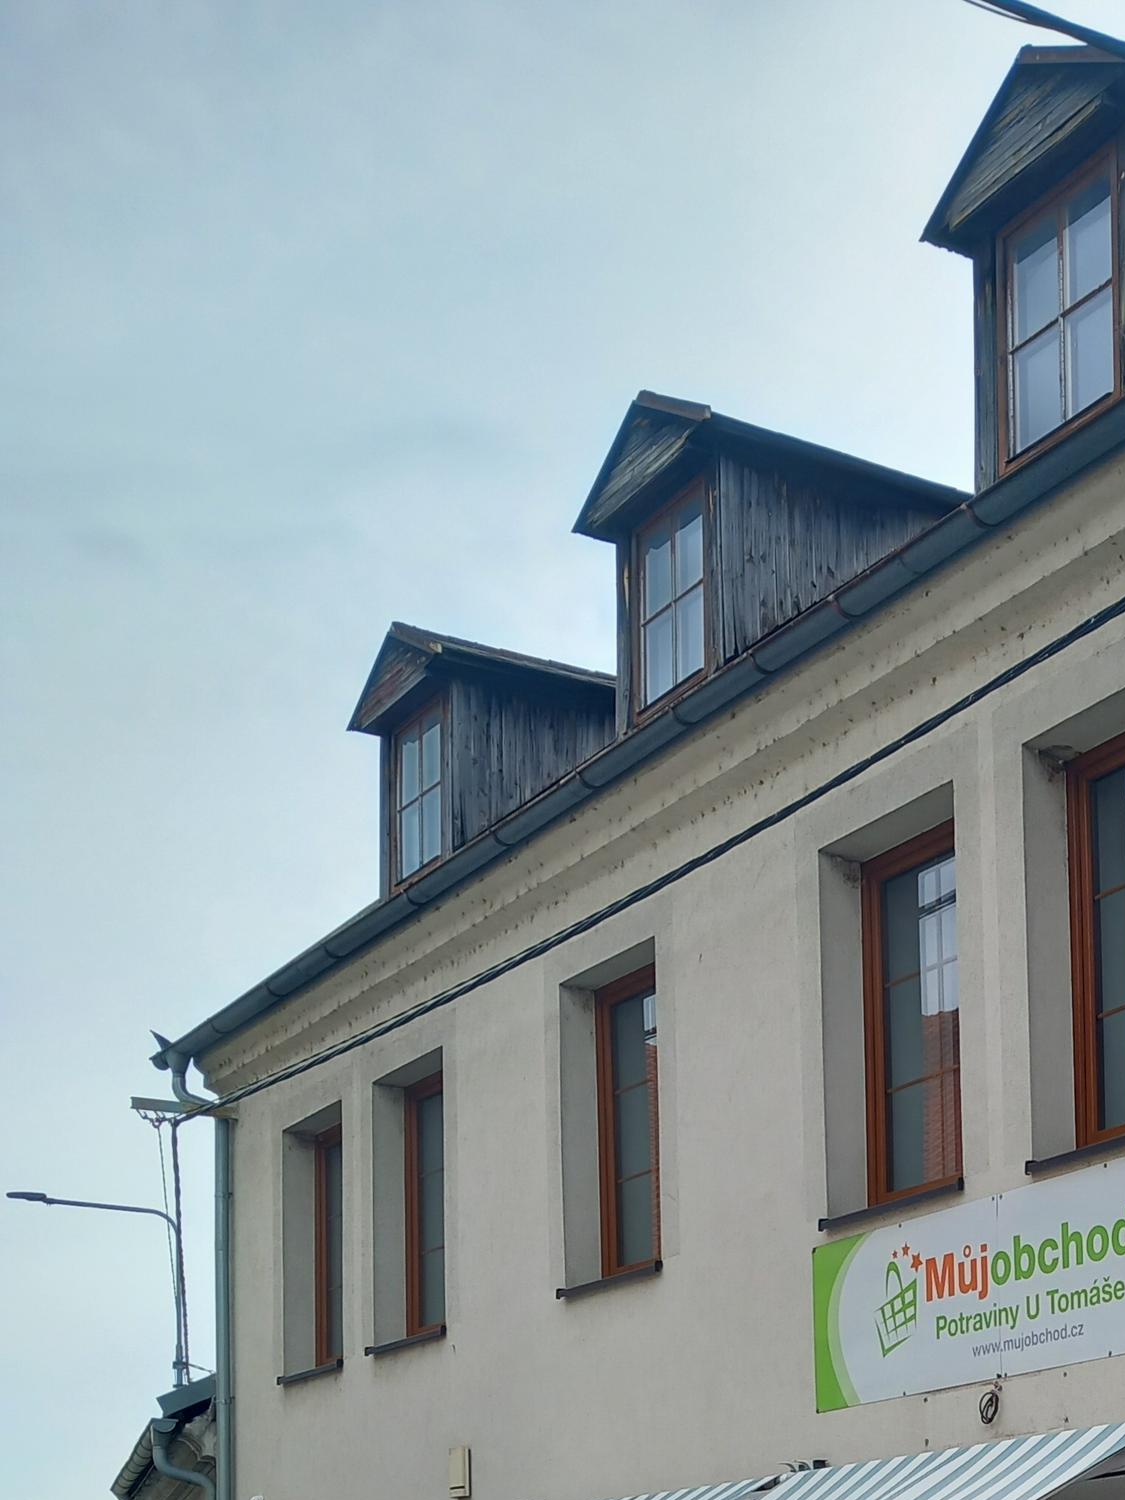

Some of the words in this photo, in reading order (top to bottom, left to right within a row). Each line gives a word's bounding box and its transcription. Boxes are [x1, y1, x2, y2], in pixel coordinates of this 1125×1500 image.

[936, 1303, 1019, 1339] Potraviny
[1025, 1295, 1040, 1319] U
[1046, 1276, 1125, 1311] Tomáše
[972, 1322, 1084, 1357] www.mujobchod.cz
